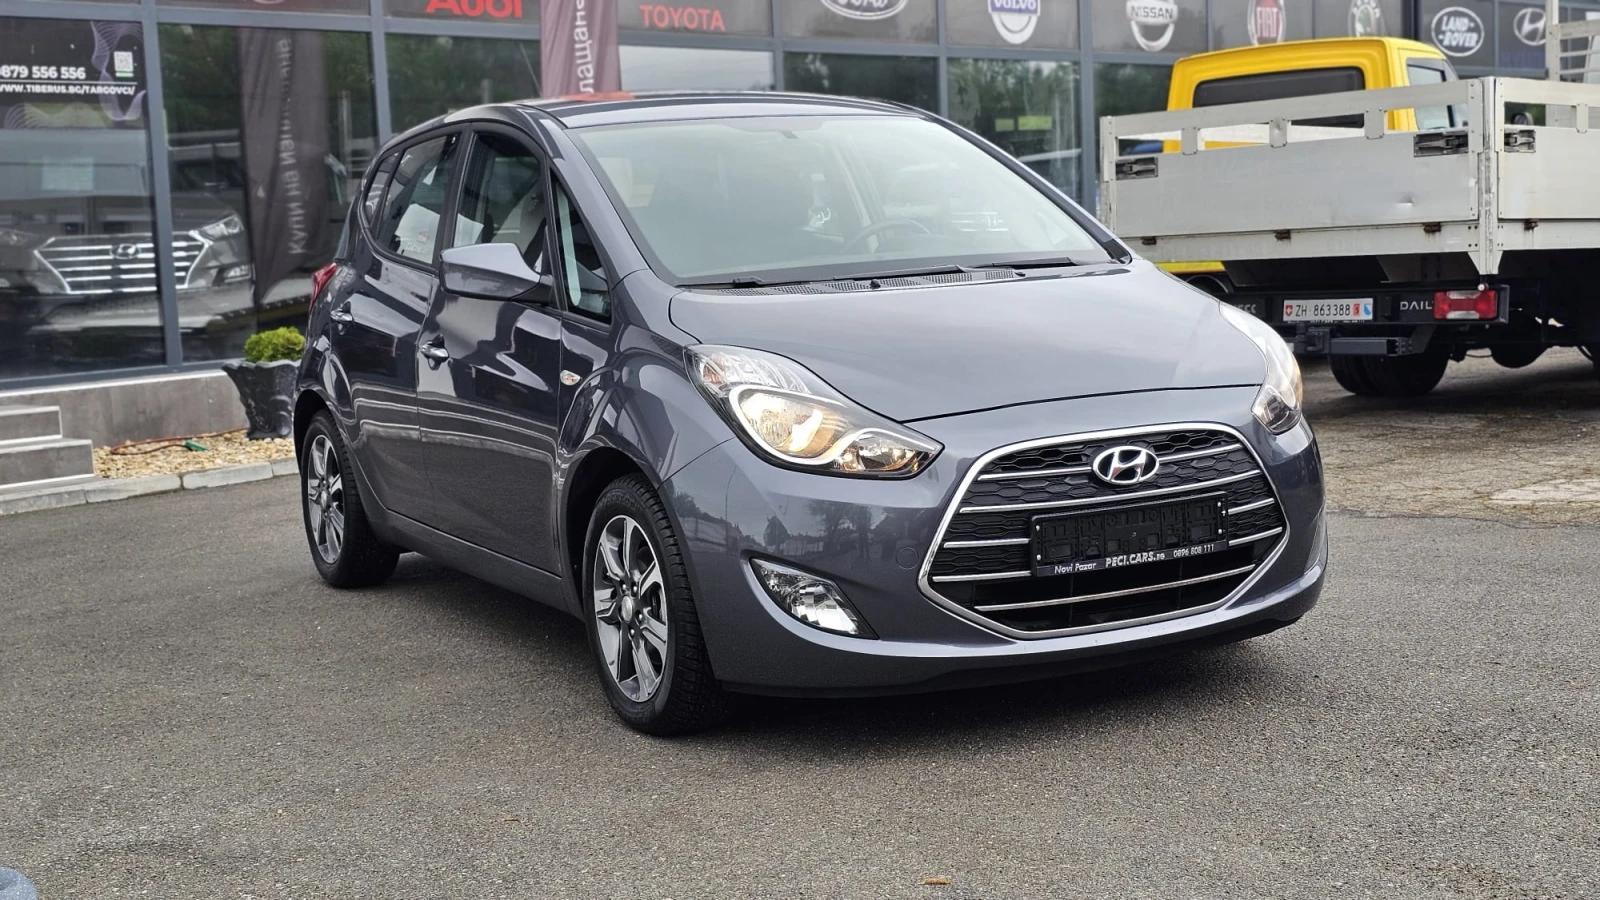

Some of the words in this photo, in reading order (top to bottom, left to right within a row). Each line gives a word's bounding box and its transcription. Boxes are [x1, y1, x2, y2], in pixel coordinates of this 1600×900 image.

[993, 0, 1037, 10] VOLVO
[1130, 5, 1174, 20] NISSAN
[640, 4, 726, 32] TOYOTA
[1255, 6, 1279, 38] FIAT
[31, 65, 59, 79] 556
[60, 66, 87, 80] 556
[1295, 304, 1308, 317] ZH
[1313, 303, 1351, 317] 863388
[1400, 301, 1434, 311] DAIL
[1054, 563, 1073, 574] Novi
[1074, 562, 1097, 572] Pazar
[1203, 543, 1214, 553] 111
